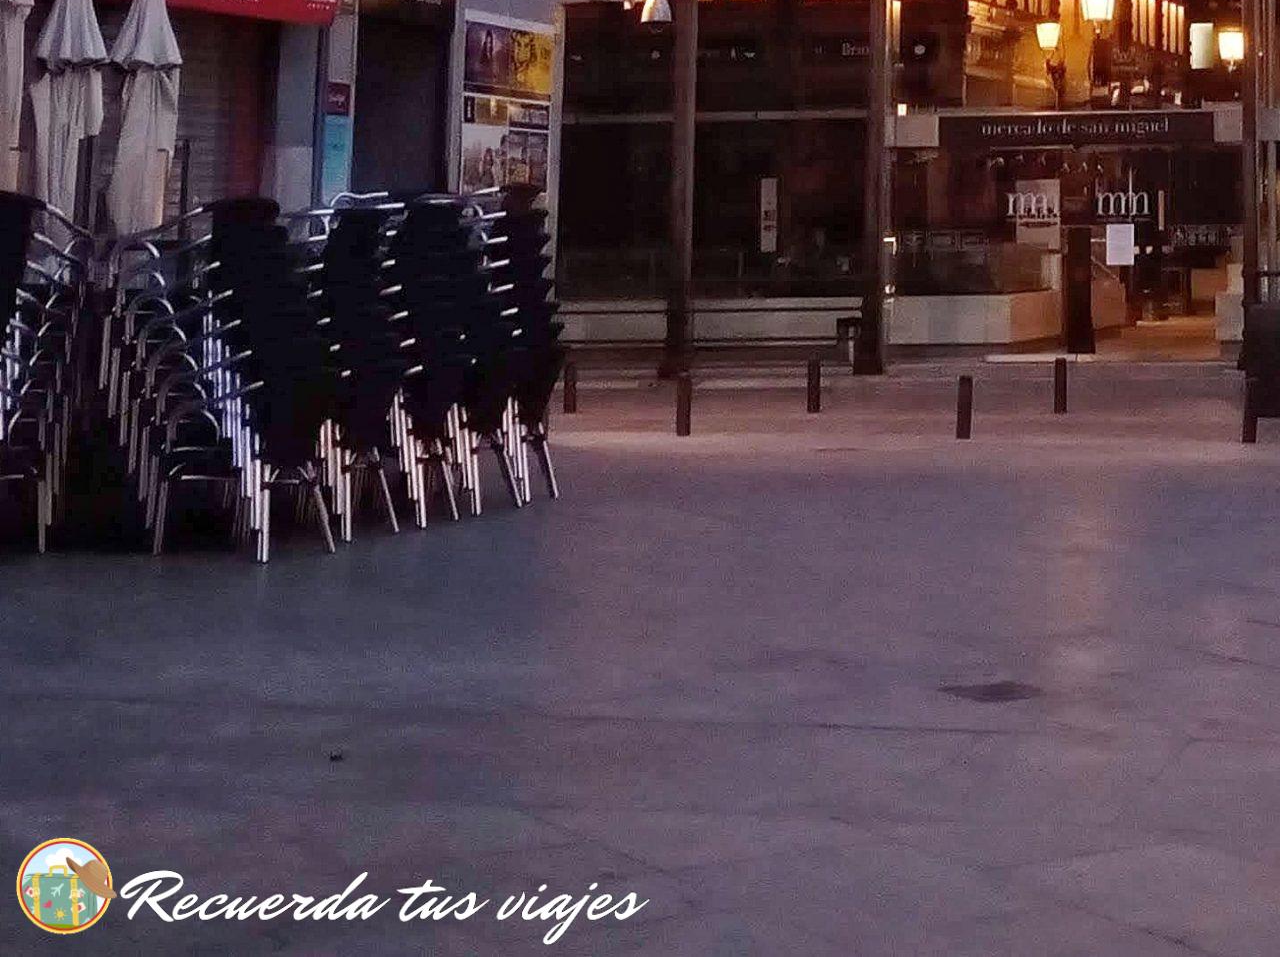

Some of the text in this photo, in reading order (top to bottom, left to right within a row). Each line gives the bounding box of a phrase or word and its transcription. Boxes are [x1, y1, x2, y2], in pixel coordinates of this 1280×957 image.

[981, 118, 1051, 135] mercado
[1056, 118, 1077, 134] de
[1114, 117, 1169, 138] miguel
